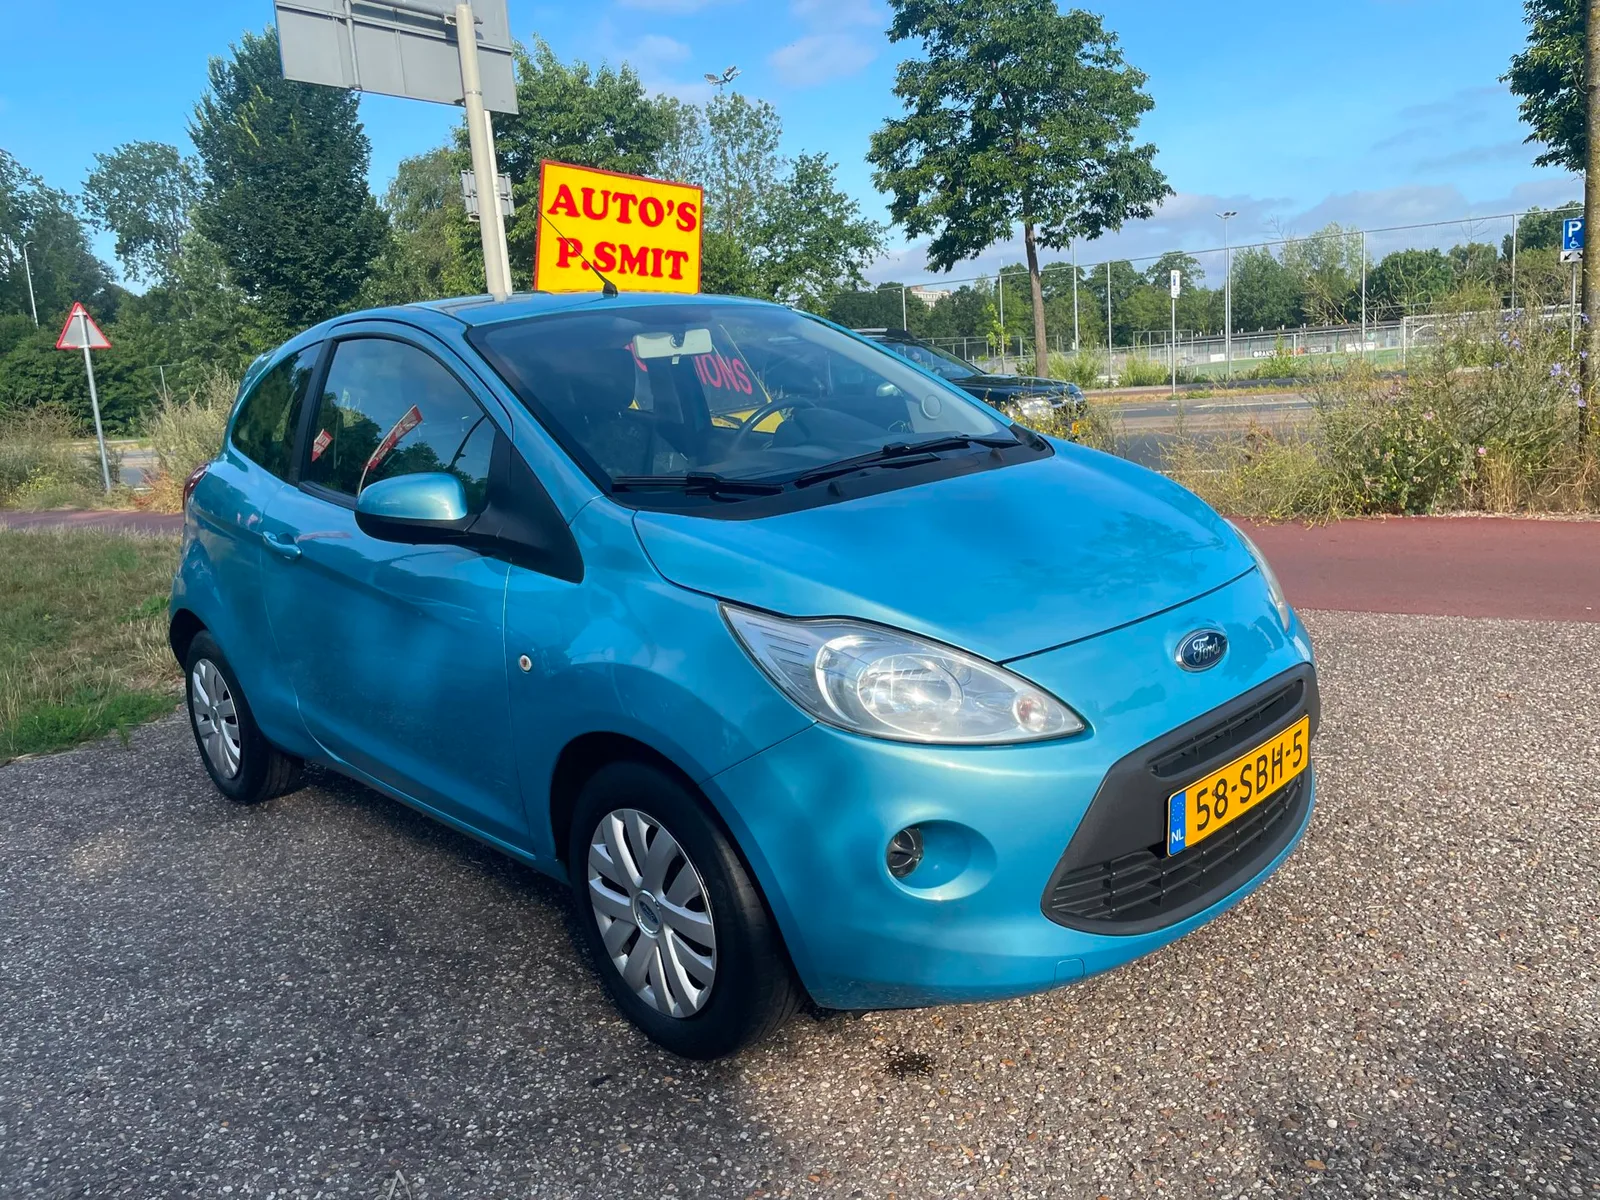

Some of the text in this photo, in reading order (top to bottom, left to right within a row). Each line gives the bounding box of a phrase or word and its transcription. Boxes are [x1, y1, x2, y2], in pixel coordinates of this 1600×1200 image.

[547, 184, 697, 232] AUTO'S
[1568, 221, 1582, 237] P
[556, 237, 689, 280] P.SMIT
[1192, 635, 1221, 663] Ford
[1196, 730, 1302, 831] 58-SBH-5
[1171, 829, 1184, 844] NL
